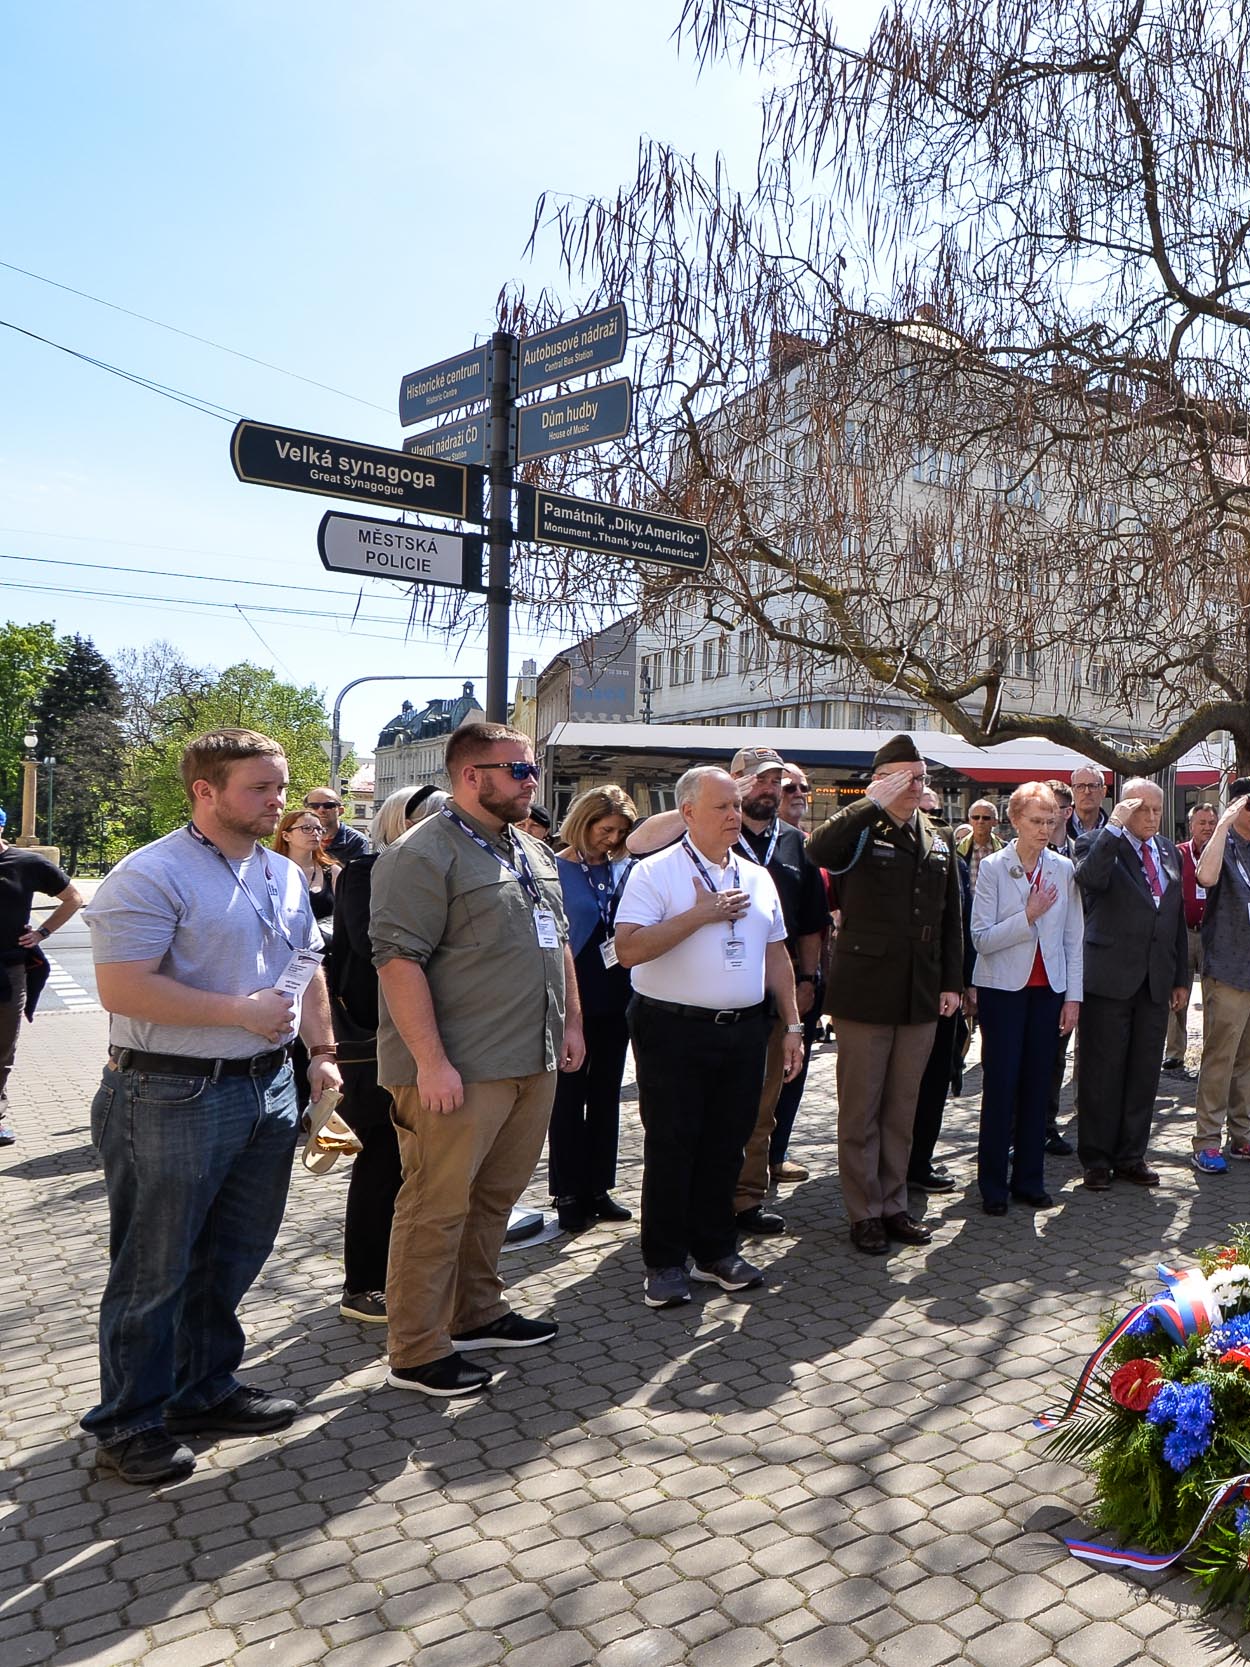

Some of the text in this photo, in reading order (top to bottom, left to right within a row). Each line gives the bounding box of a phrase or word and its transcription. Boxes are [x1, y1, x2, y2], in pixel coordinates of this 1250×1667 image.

[524, 317, 618, 367] Autobusové nádraží
[544, 349, 594, 373] Central Bus Station
[406, 362, 480, 400] Historické centrum
[442, 388, 458, 400] Centre
[542, 401, 599, 429] Dům hudby
[435, 429, 464, 453] nádraží
[465, 424, 478, 444] ČD
[548, 423, 590, 441] House of Music
[275, 439, 436, 489] Velká synagoga
[310, 469, 404, 495] Great Synagogue
[544, 502, 605, 527] Památník
[358, 528, 438, 554] MĚSTSKÁ
[544, 521, 591, 539] Monument
[631, 540, 653, 552] you,
[365, 550, 432, 573] POLICIE
